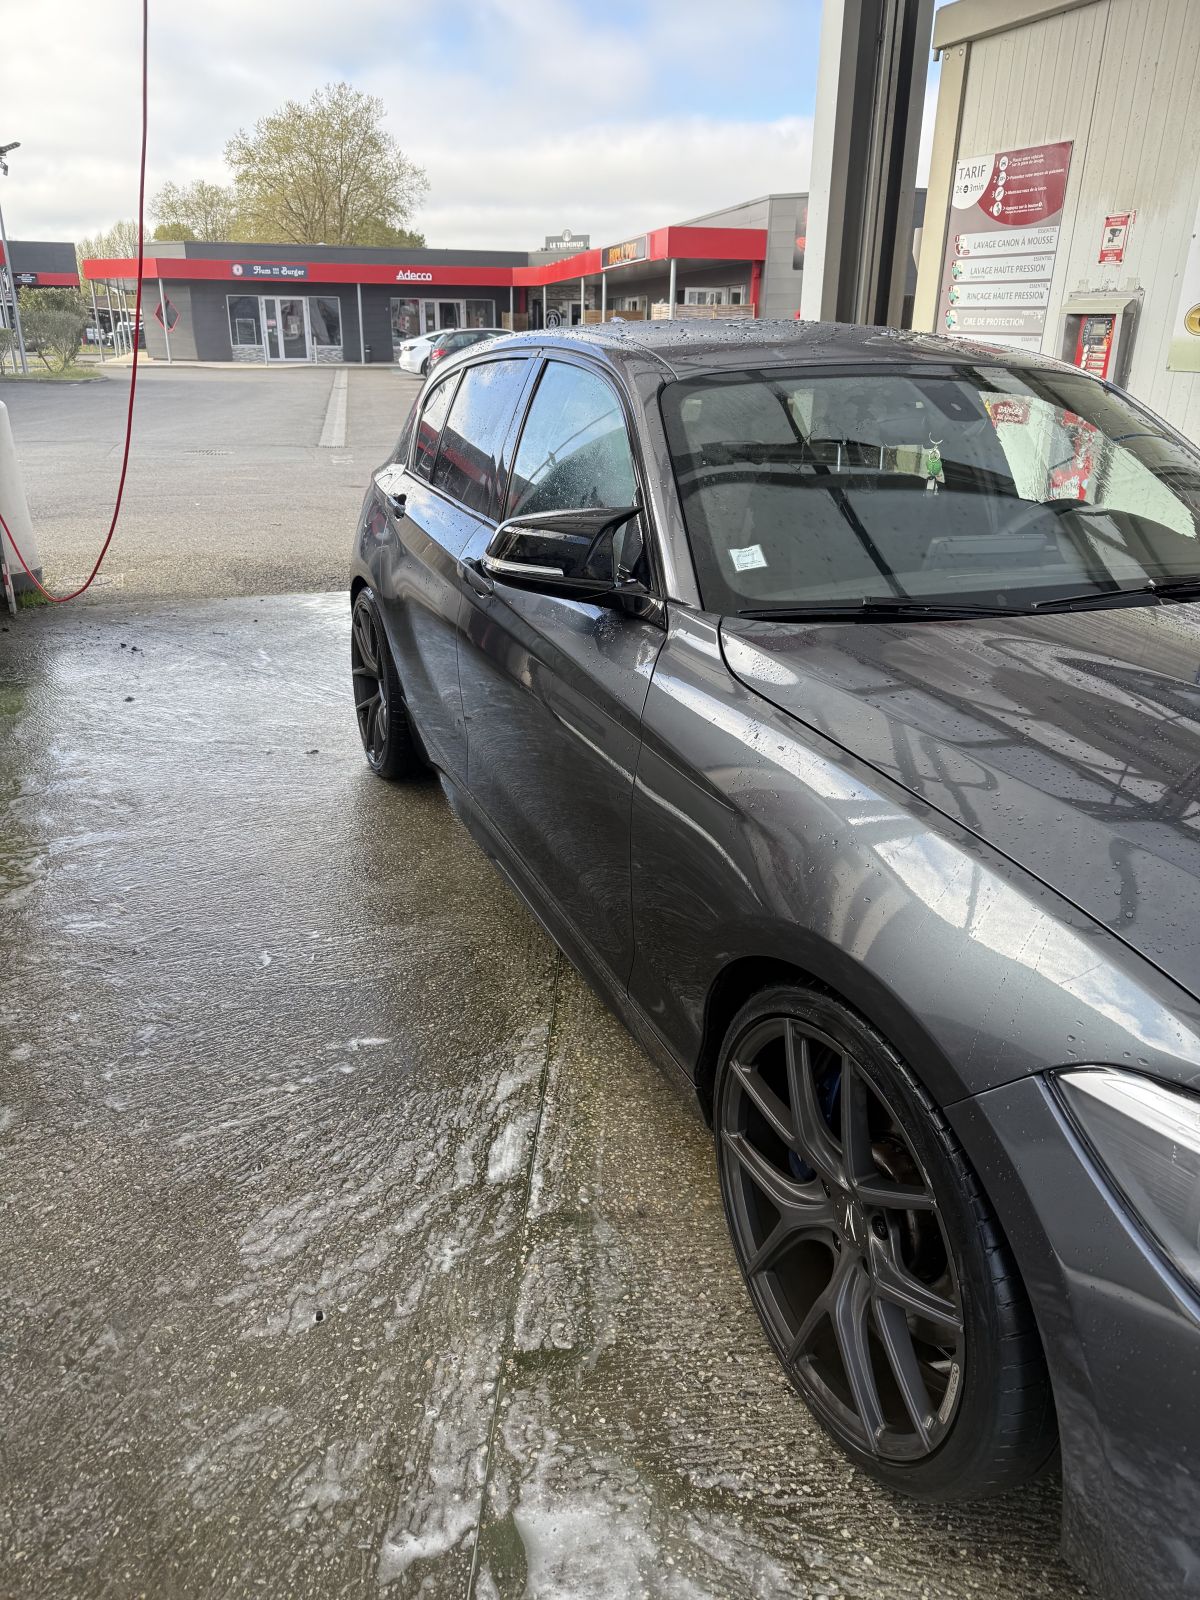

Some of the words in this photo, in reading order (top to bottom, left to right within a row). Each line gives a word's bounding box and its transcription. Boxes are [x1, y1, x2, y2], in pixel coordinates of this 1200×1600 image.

[959, 165, 987, 180] TARIF
[970, 182, 985, 192] 3min
[557, 241, 585, 249] TERMINUS
[974, 240, 998, 250] LAVAGE
[998, 237, 1020, 248] CANON
[1028, 235, 1054, 246] MOUSSE
[281, 266, 305, 277] Burger
[970, 266, 993, 275] LAVAGE
[994, 265, 1014, 274] HAUTE
[1016, 263, 1046, 273] PRESSION
[396, 269, 433, 281] Adecco
[967, 293, 992, 302] RINÇAGE
[993, 292, 1013, 300] HAUTE
[1014, 291, 1044, 300] PRESSION
[963, 317, 978, 326] CIRE
[979, 317, 987, 326] DE
[987, 317, 1025, 327] PROTECTION
